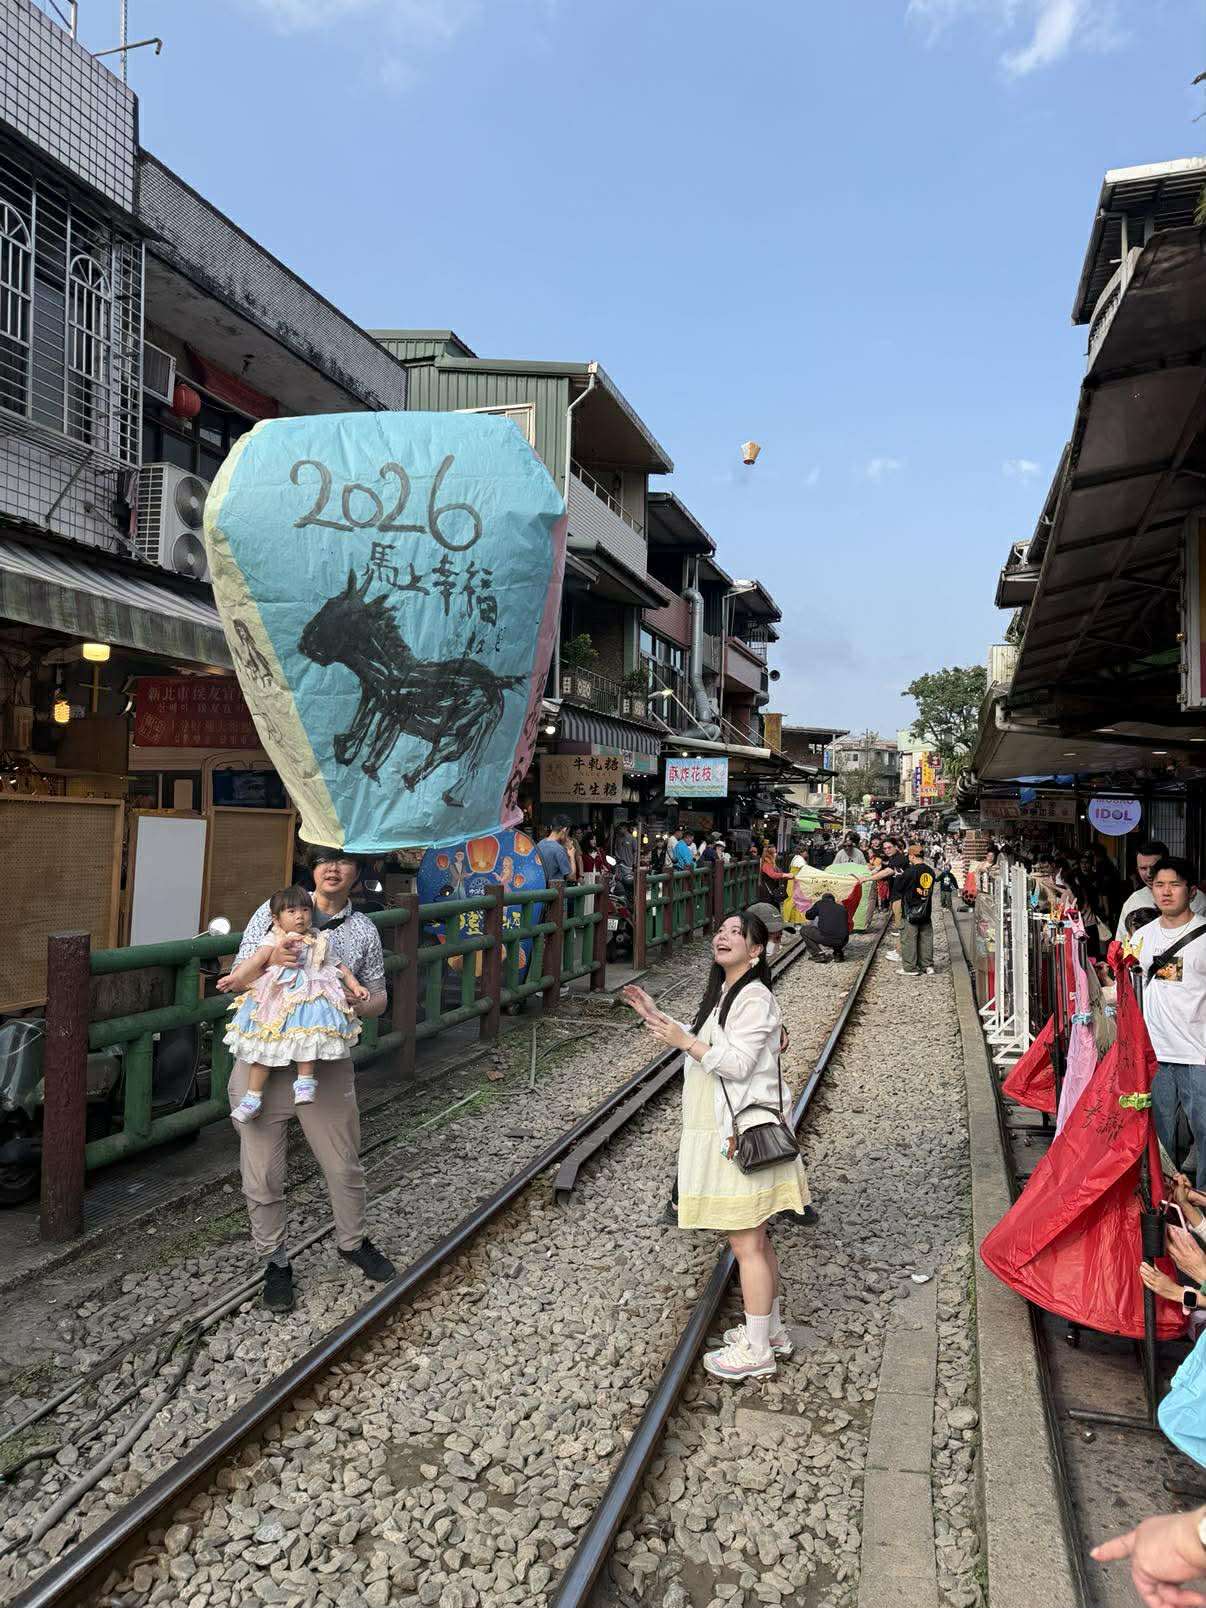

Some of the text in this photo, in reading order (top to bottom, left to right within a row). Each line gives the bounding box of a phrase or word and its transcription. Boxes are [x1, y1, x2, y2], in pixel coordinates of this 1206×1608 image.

[290, 454, 482, 552] 2026
[362, 541, 498, 628] 馬上幸福
[573, 756, 619, 771] 牛軋糖
[572, 782, 617, 797] 花生糖
[1095, 808, 1133, 822] IDOL
